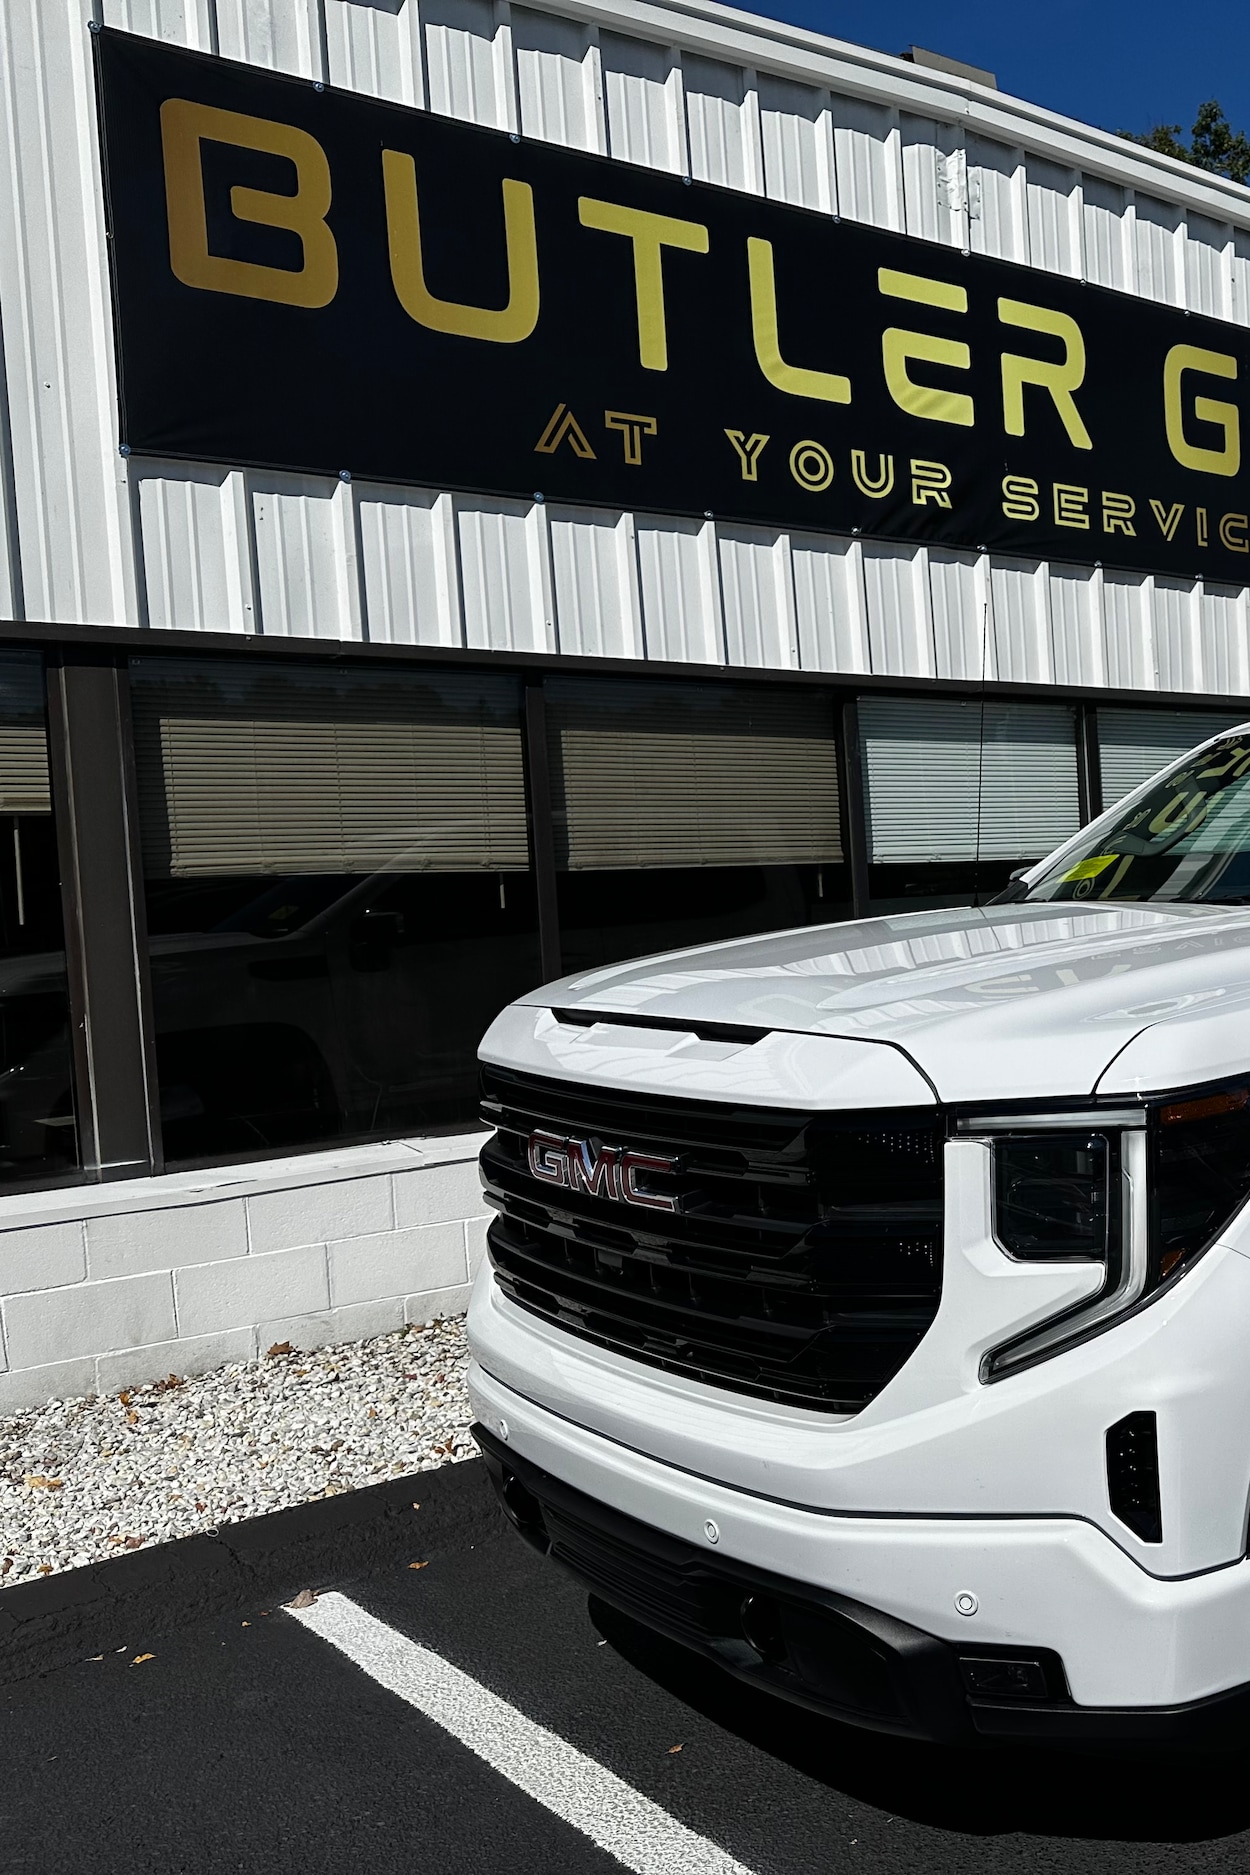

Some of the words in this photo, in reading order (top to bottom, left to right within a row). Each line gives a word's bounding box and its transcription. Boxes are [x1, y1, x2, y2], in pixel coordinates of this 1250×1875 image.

[159, 98, 1094, 450] BUTLER
[534, 403, 658, 466] AT
[724, 428, 953, 509] YOUR
[528, 1128, 684, 1213] GMC
